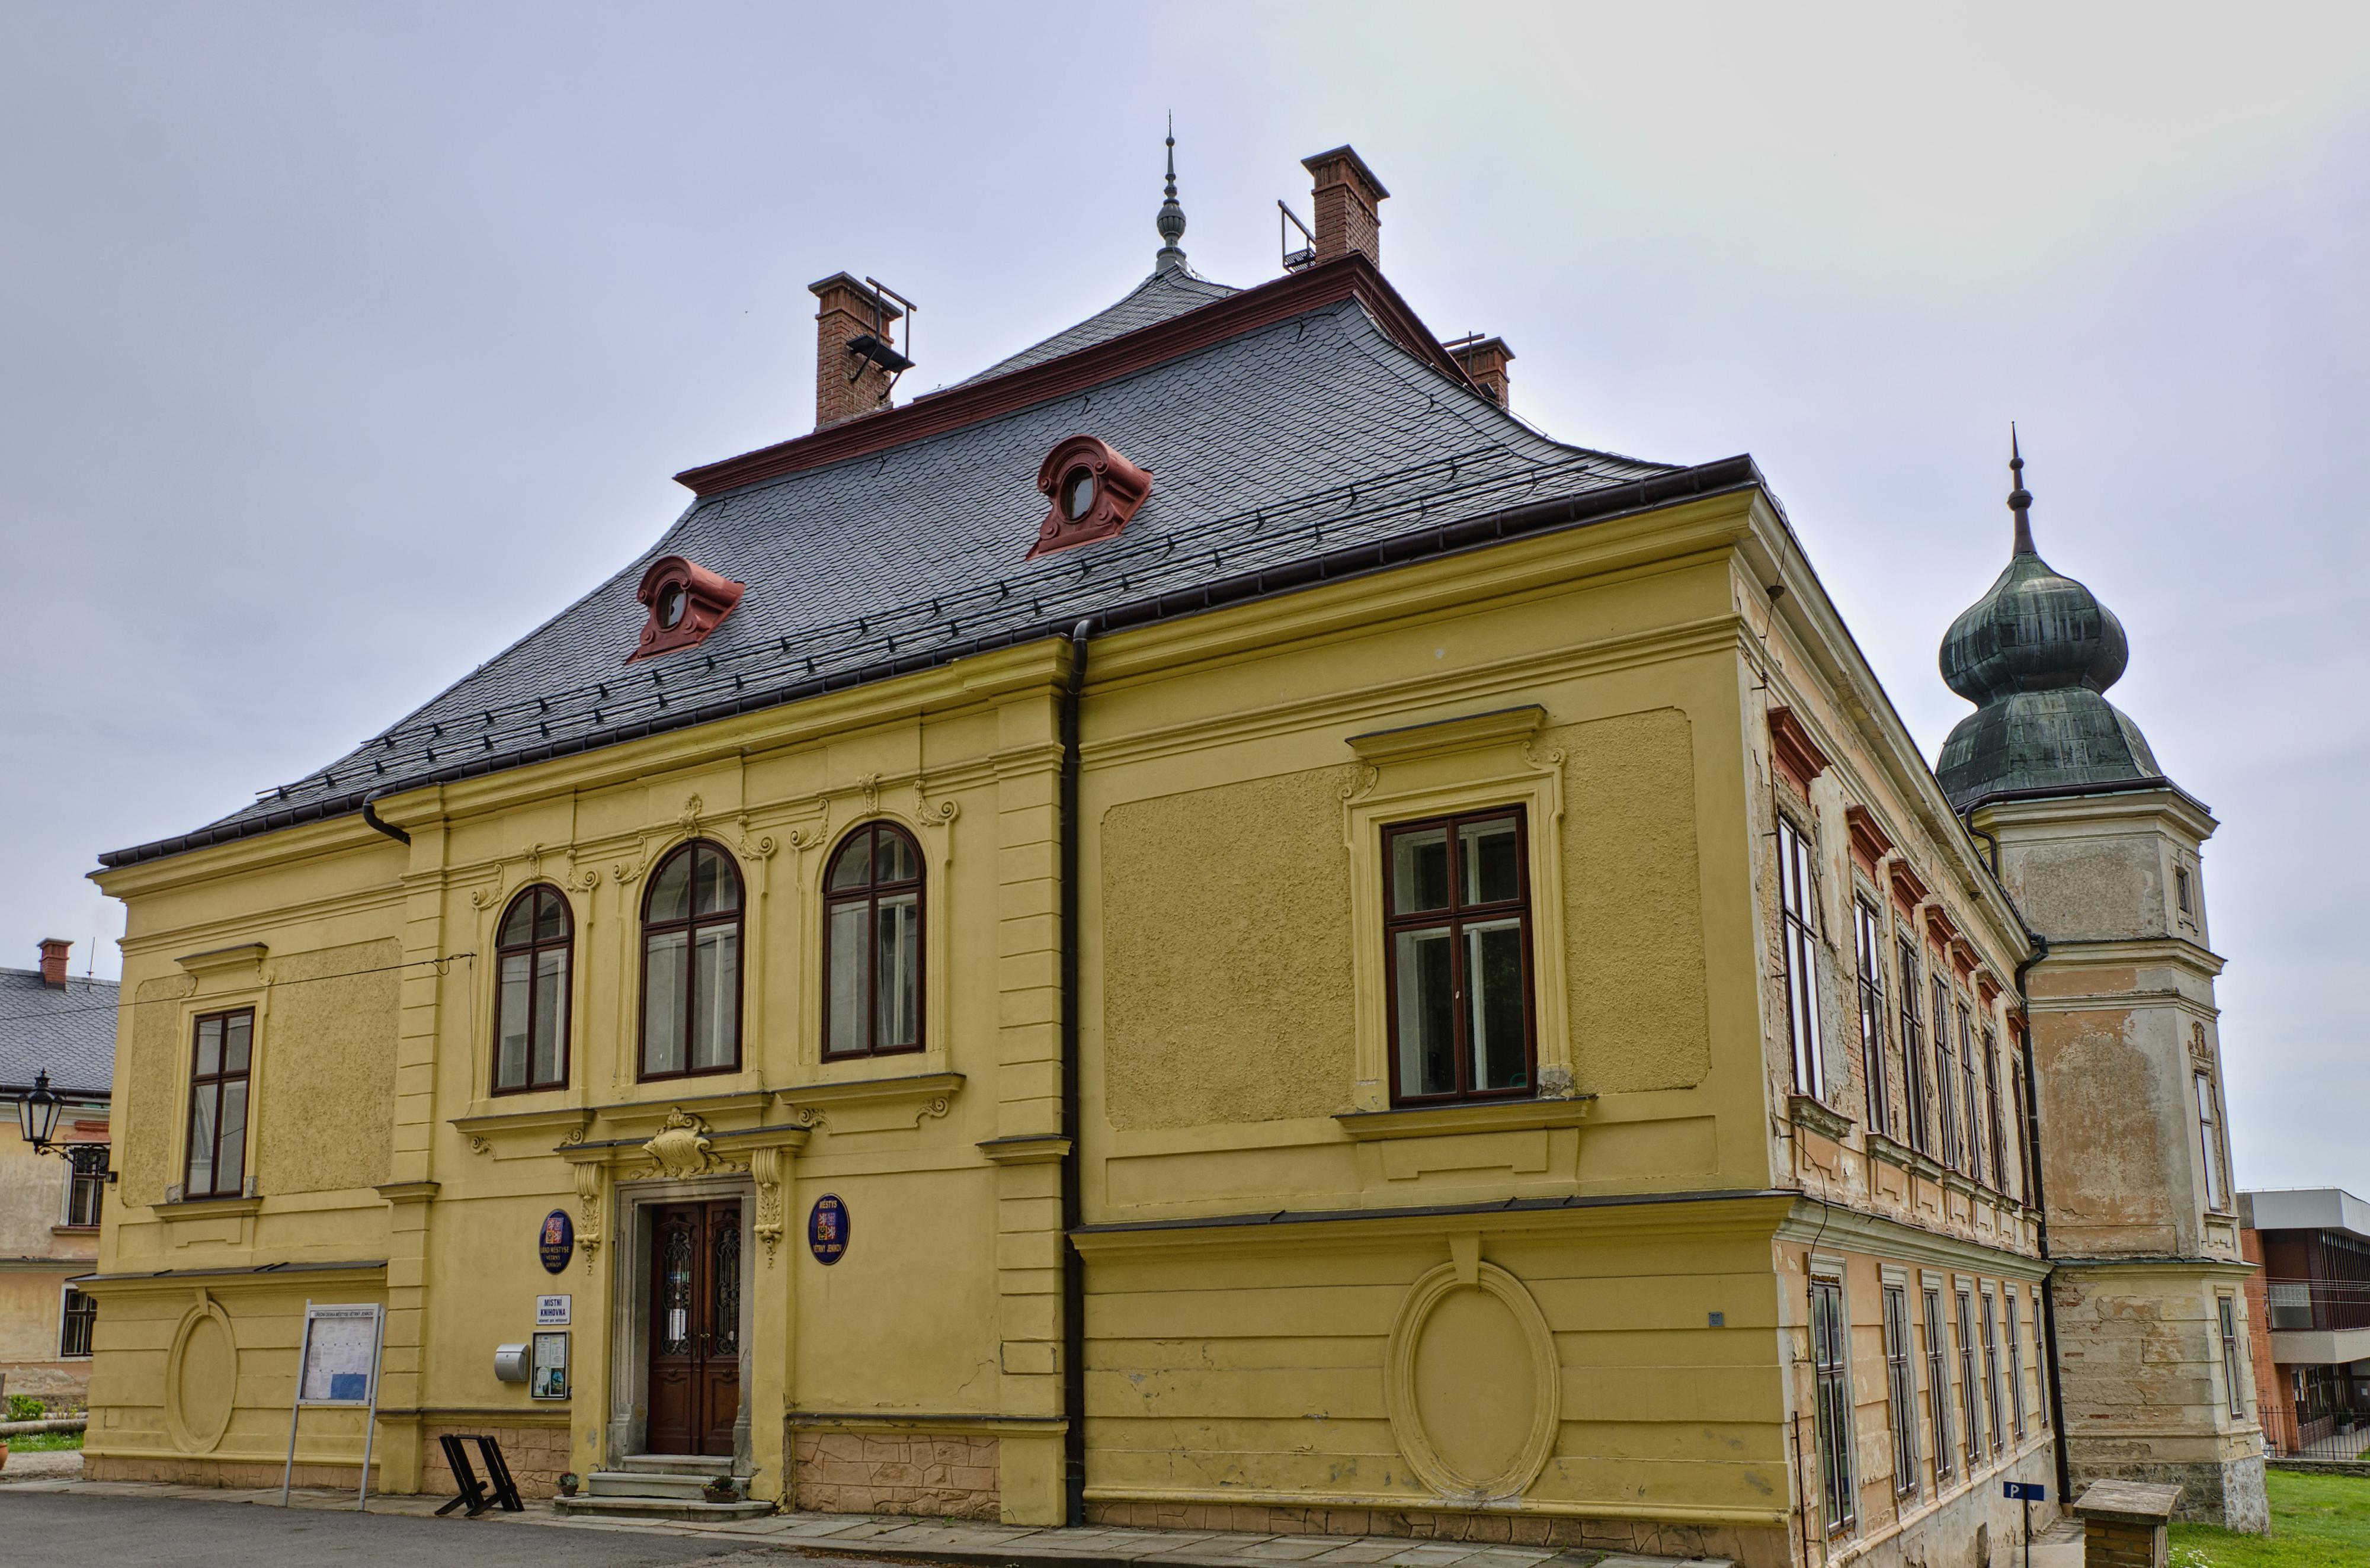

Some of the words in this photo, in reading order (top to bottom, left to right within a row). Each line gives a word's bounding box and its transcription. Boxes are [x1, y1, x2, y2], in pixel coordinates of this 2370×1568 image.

[819, 1200, 837, 1208] MĚSTYS
[544, 1297, 562, 1306] MÍSTNÍ
[540, 1308, 566, 1316] KNIHOVNA
[2010, 1484, 2019, 1498] P
